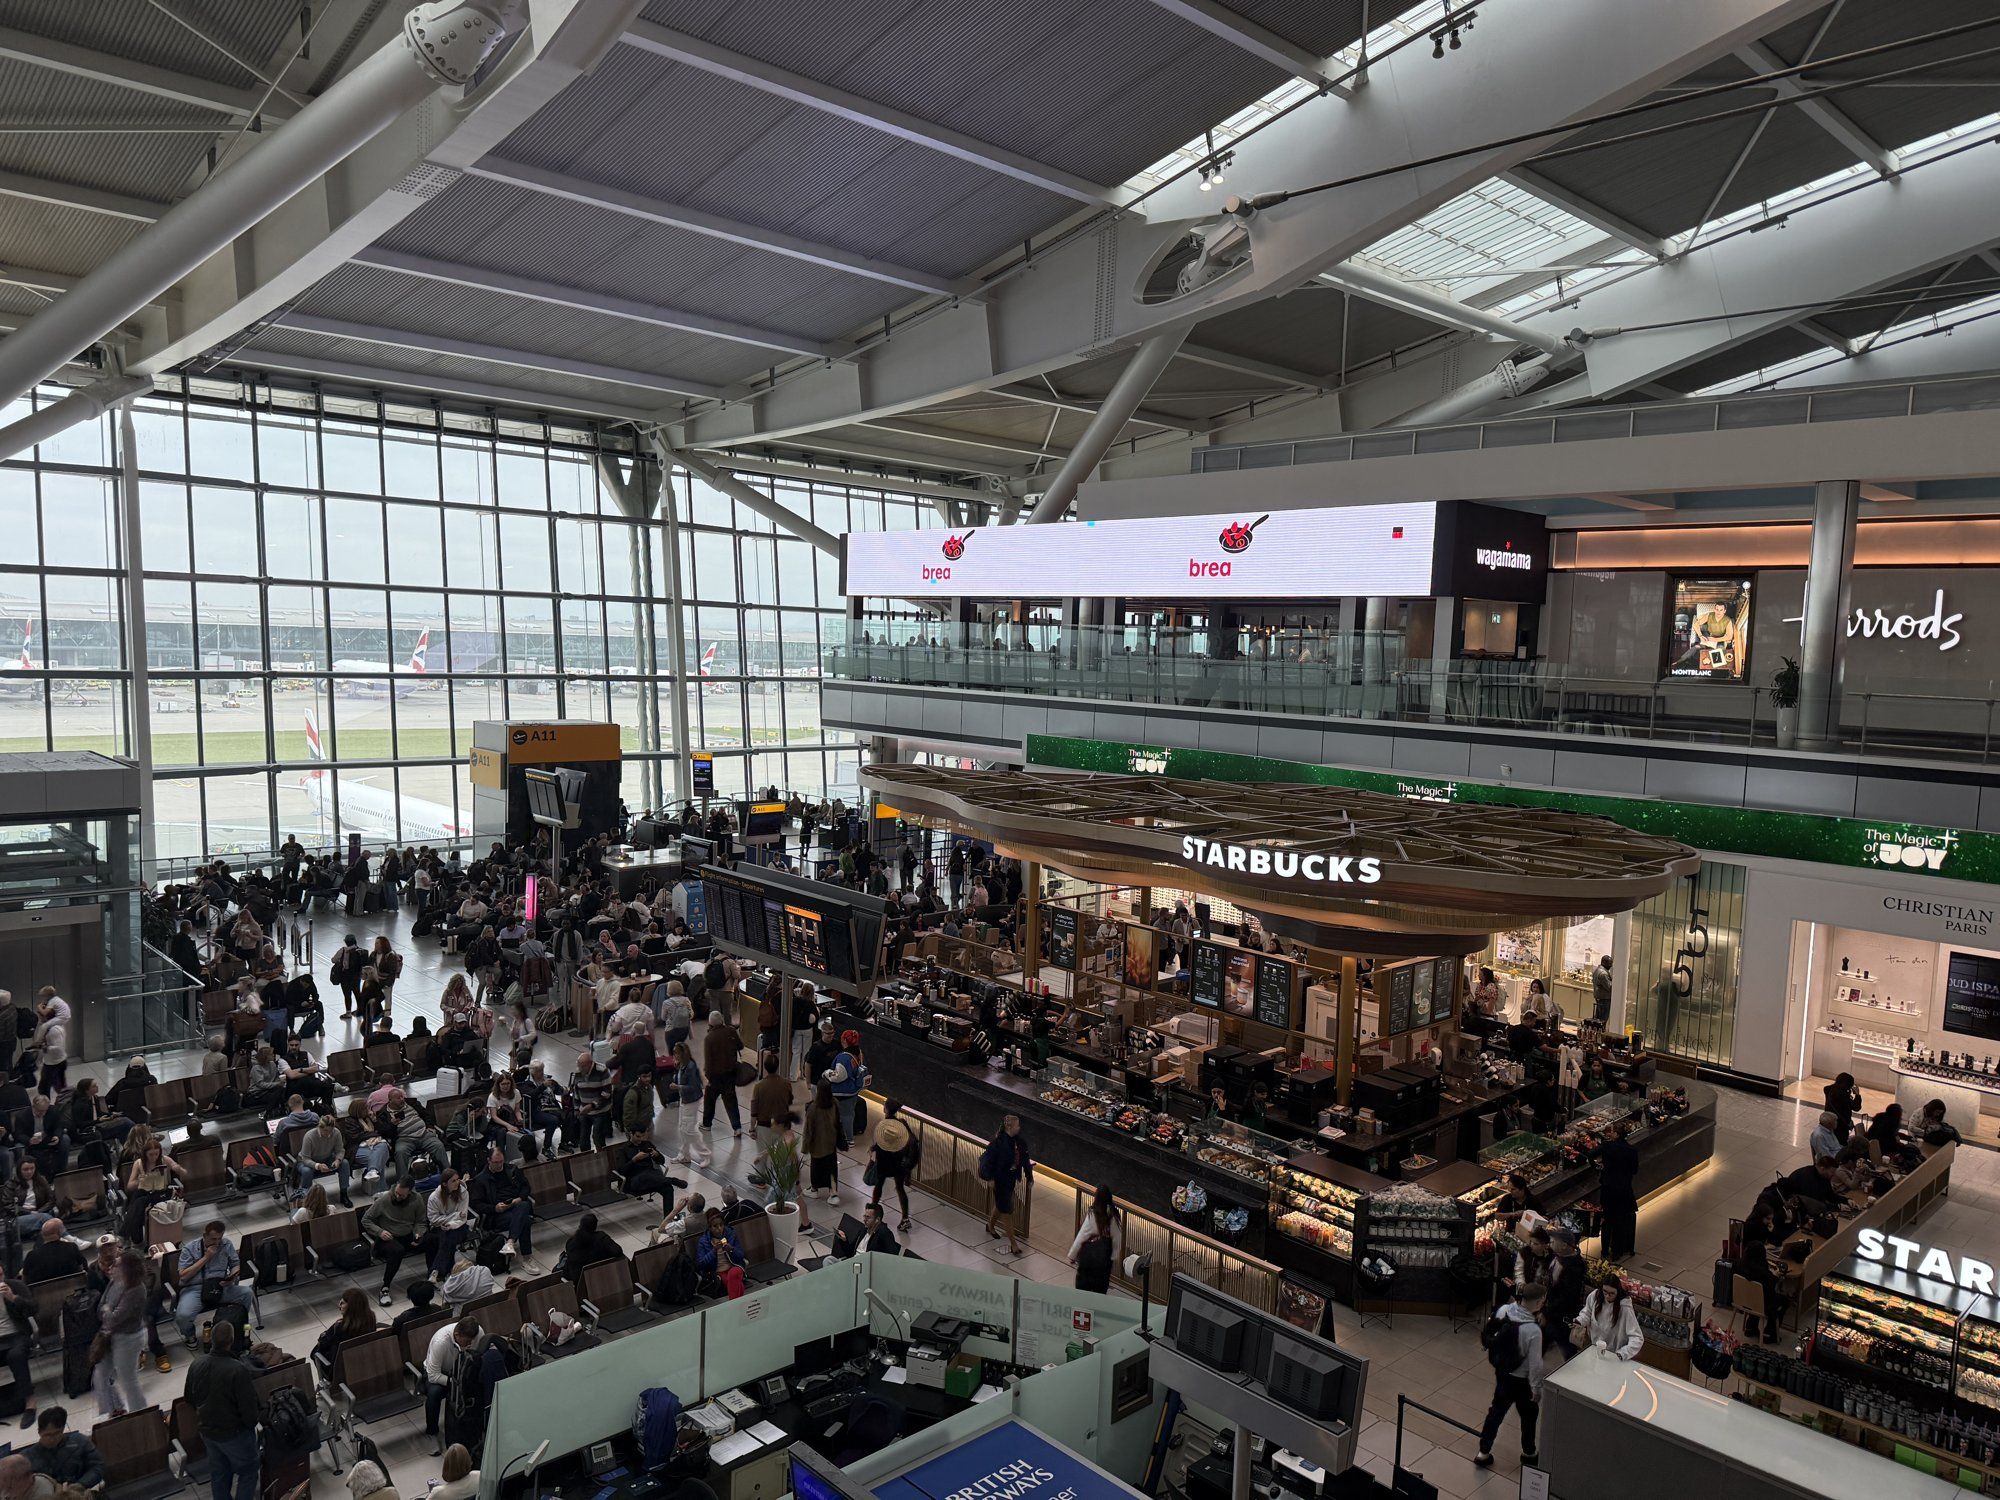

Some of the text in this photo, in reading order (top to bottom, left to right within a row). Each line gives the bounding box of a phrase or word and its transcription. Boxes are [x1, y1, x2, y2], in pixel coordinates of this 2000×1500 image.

[1189, 558, 1231, 577] brea
[1476, 548, 1532, 570] wagamama
[922, 564, 951, 580] brea
[1783, 580, 1963, 651] rrods
[531, 730, 557, 741] A11
[478, 756, 490, 767] A11
[1128, 748, 1163, 760] The Magic
[1128, 757, 1167, 774] of JOY
[1397, 782, 1413, 793] The
[1415, 784, 1443, 798] Magic
[1865, 828, 1937, 848] The Magic
[1182, 835, 1381, 884] STARBUCKS
[1863, 842, 1948, 870] of JOY
[1883, 896, 1994, 924] CHRISTIAN
[1945, 920, 1987, 936] PARIS
[1856, 1228, 1995, 1296] STAR
